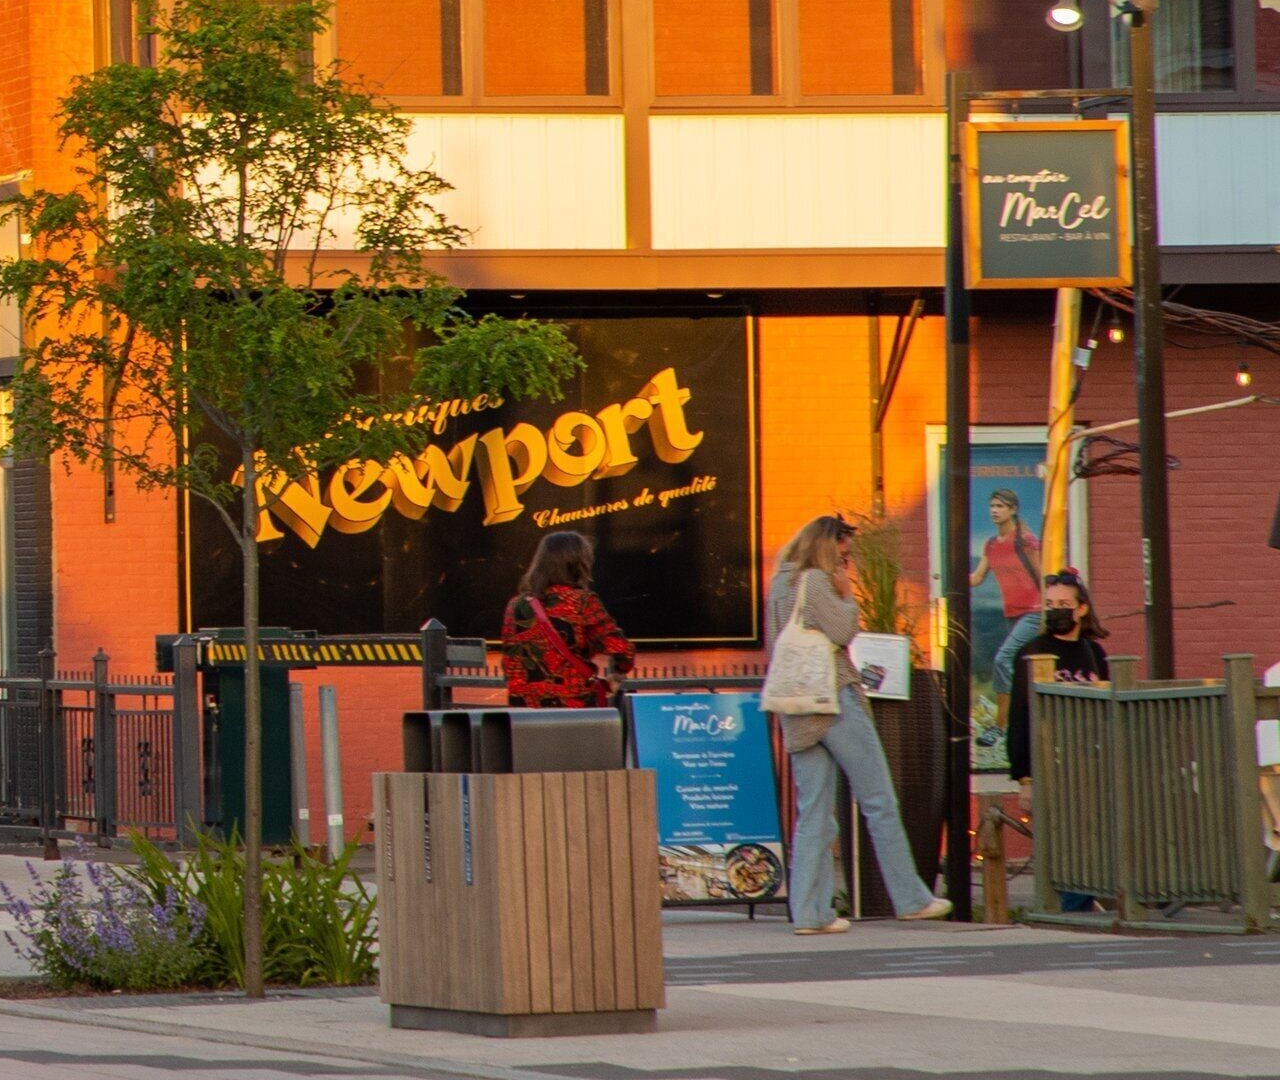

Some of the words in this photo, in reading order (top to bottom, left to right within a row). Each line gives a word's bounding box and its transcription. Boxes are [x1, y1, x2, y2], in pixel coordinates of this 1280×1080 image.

[982, 175, 1004, 184] au
[231, 366, 705, 550] Newport
[532, 497, 630, 528] Chaussures
[633, 487, 654, 508] de
[658, 475, 718, 508] qualité
